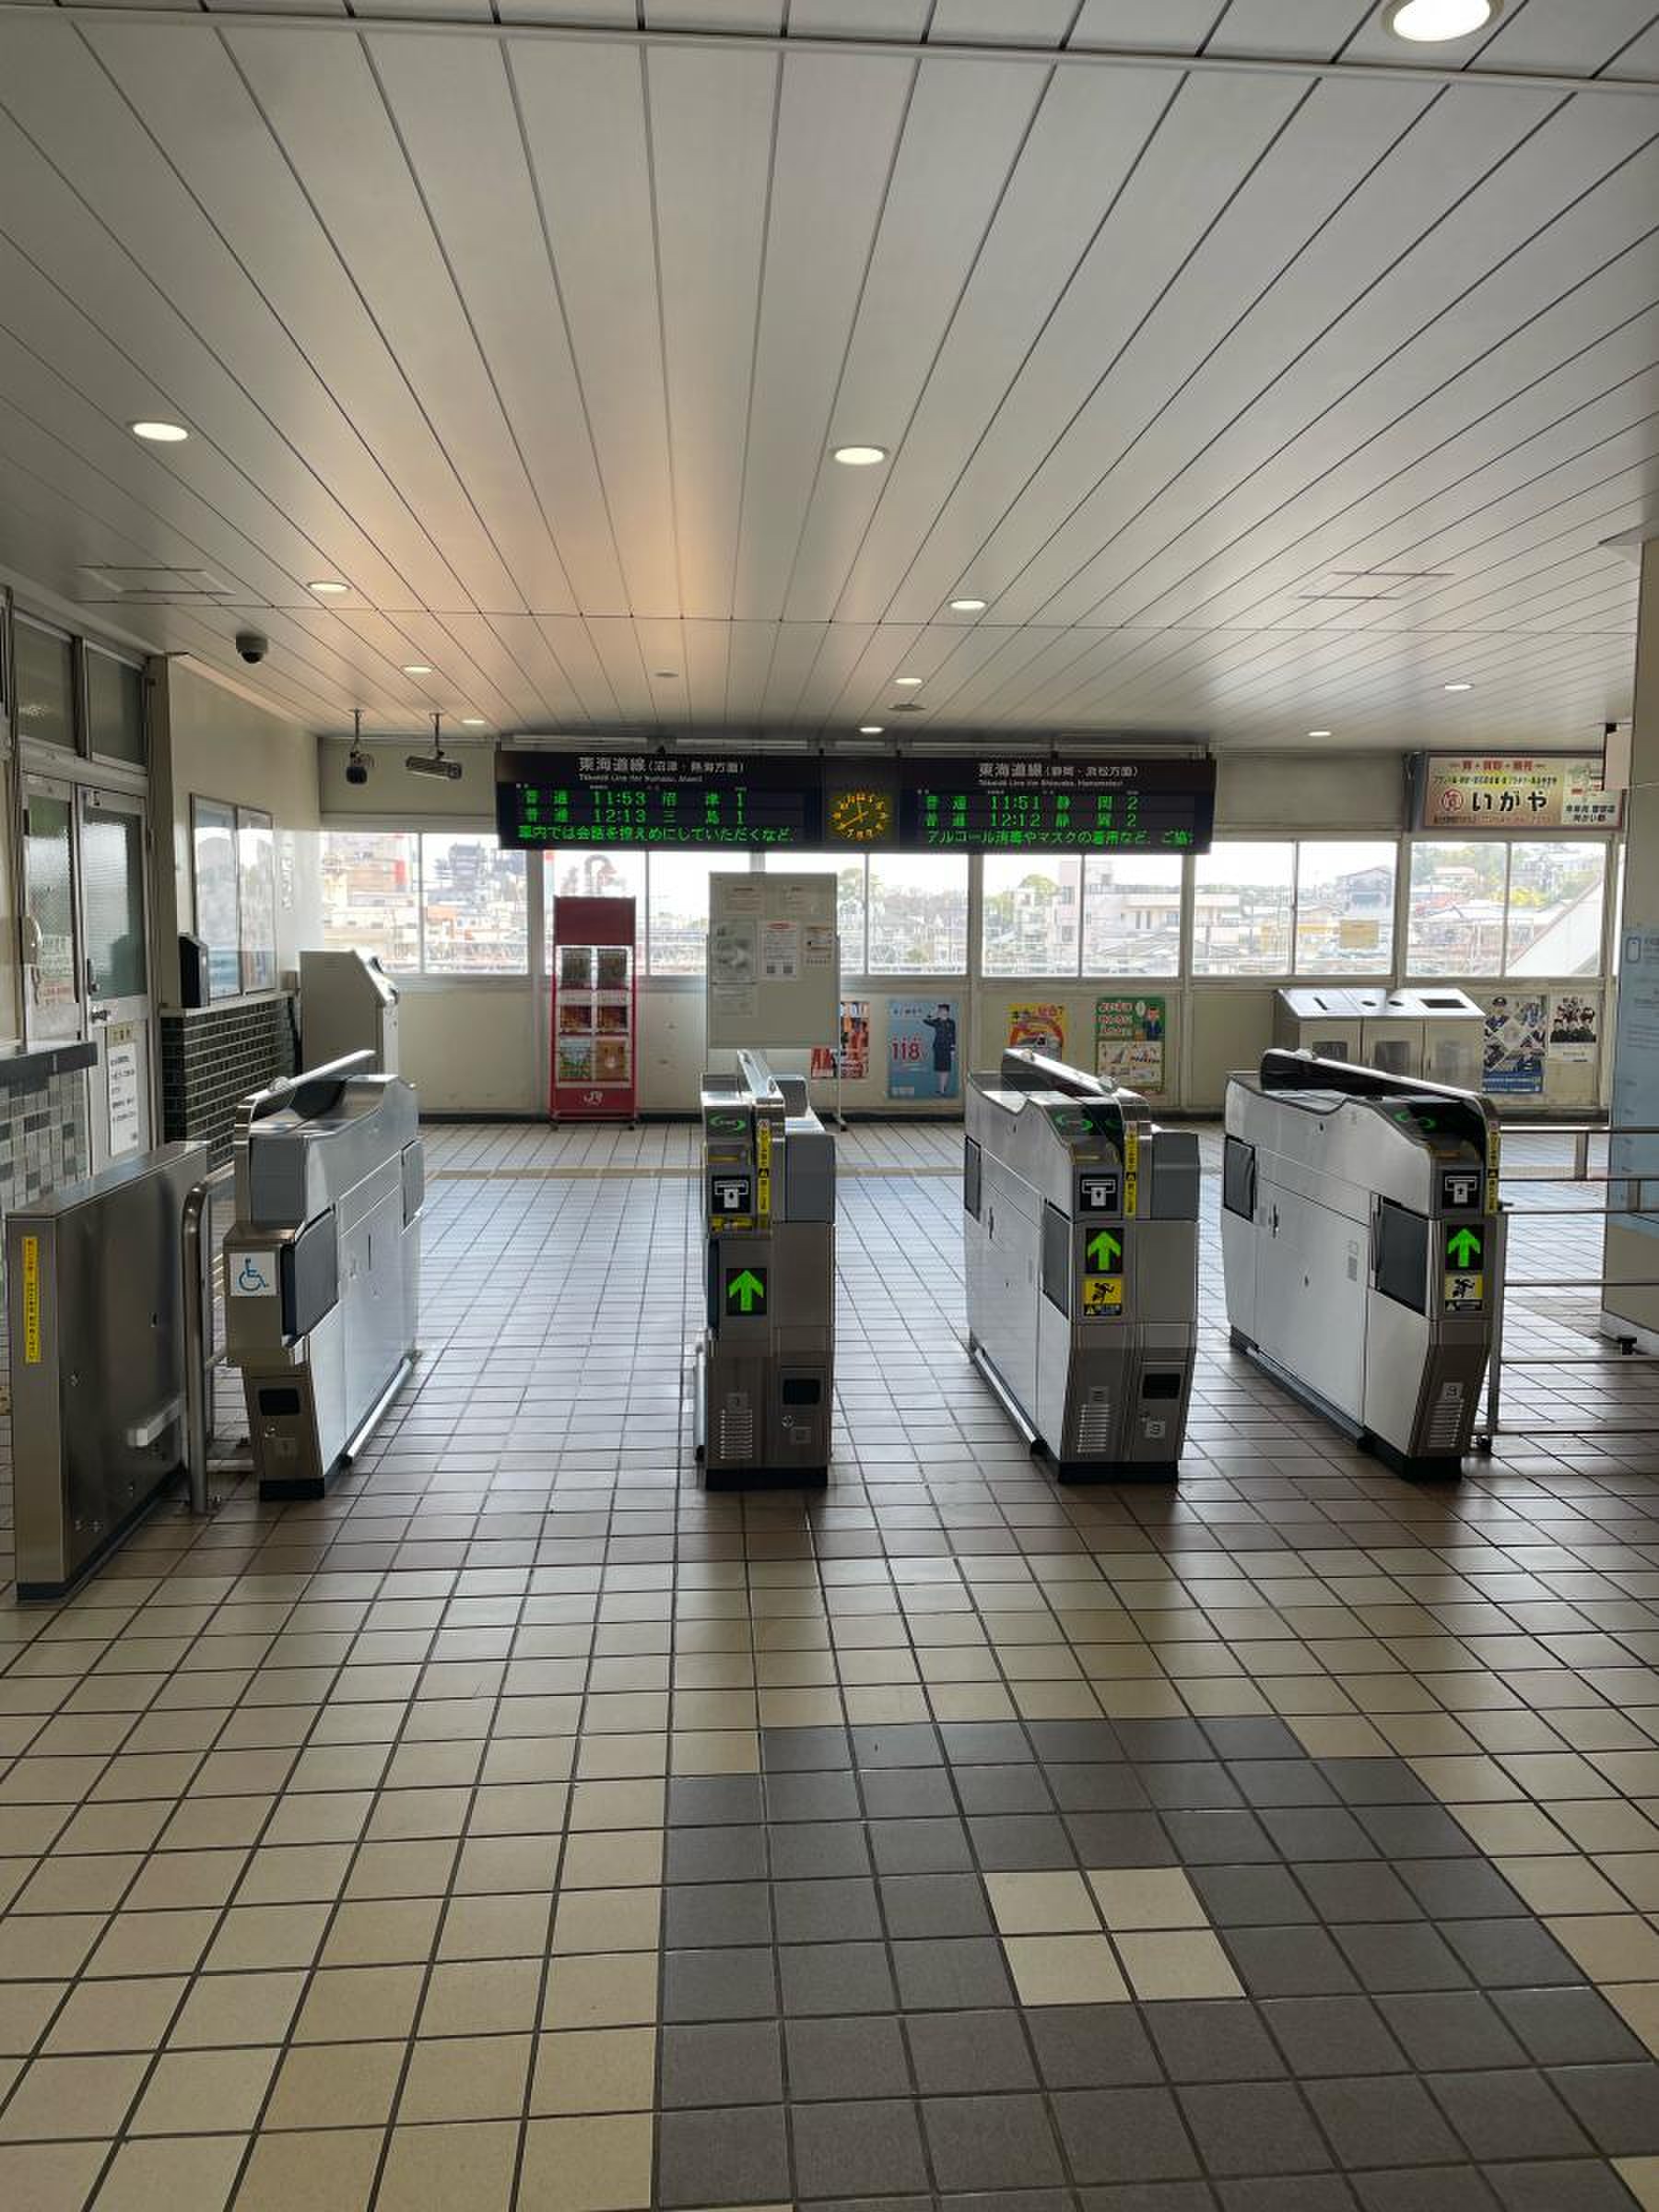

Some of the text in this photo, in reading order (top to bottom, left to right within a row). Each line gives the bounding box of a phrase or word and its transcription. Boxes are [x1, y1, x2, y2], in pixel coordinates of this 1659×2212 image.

[594, 791, 646, 805] 11:53
[736, 792, 745, 806] 1
[990, 795, 1041, 809] 11:51
[1127, 795, 1137, 809] 2
[1472, 791, 1547, 812] いがや
[594, 808, 646, 822] 12:13
[736, 809, 745, 824] 1
[990, 812, 1041, 826] 12:12
[1127, 812, 1137, 826] 2
[891, 1042, 921, 1060] 118
